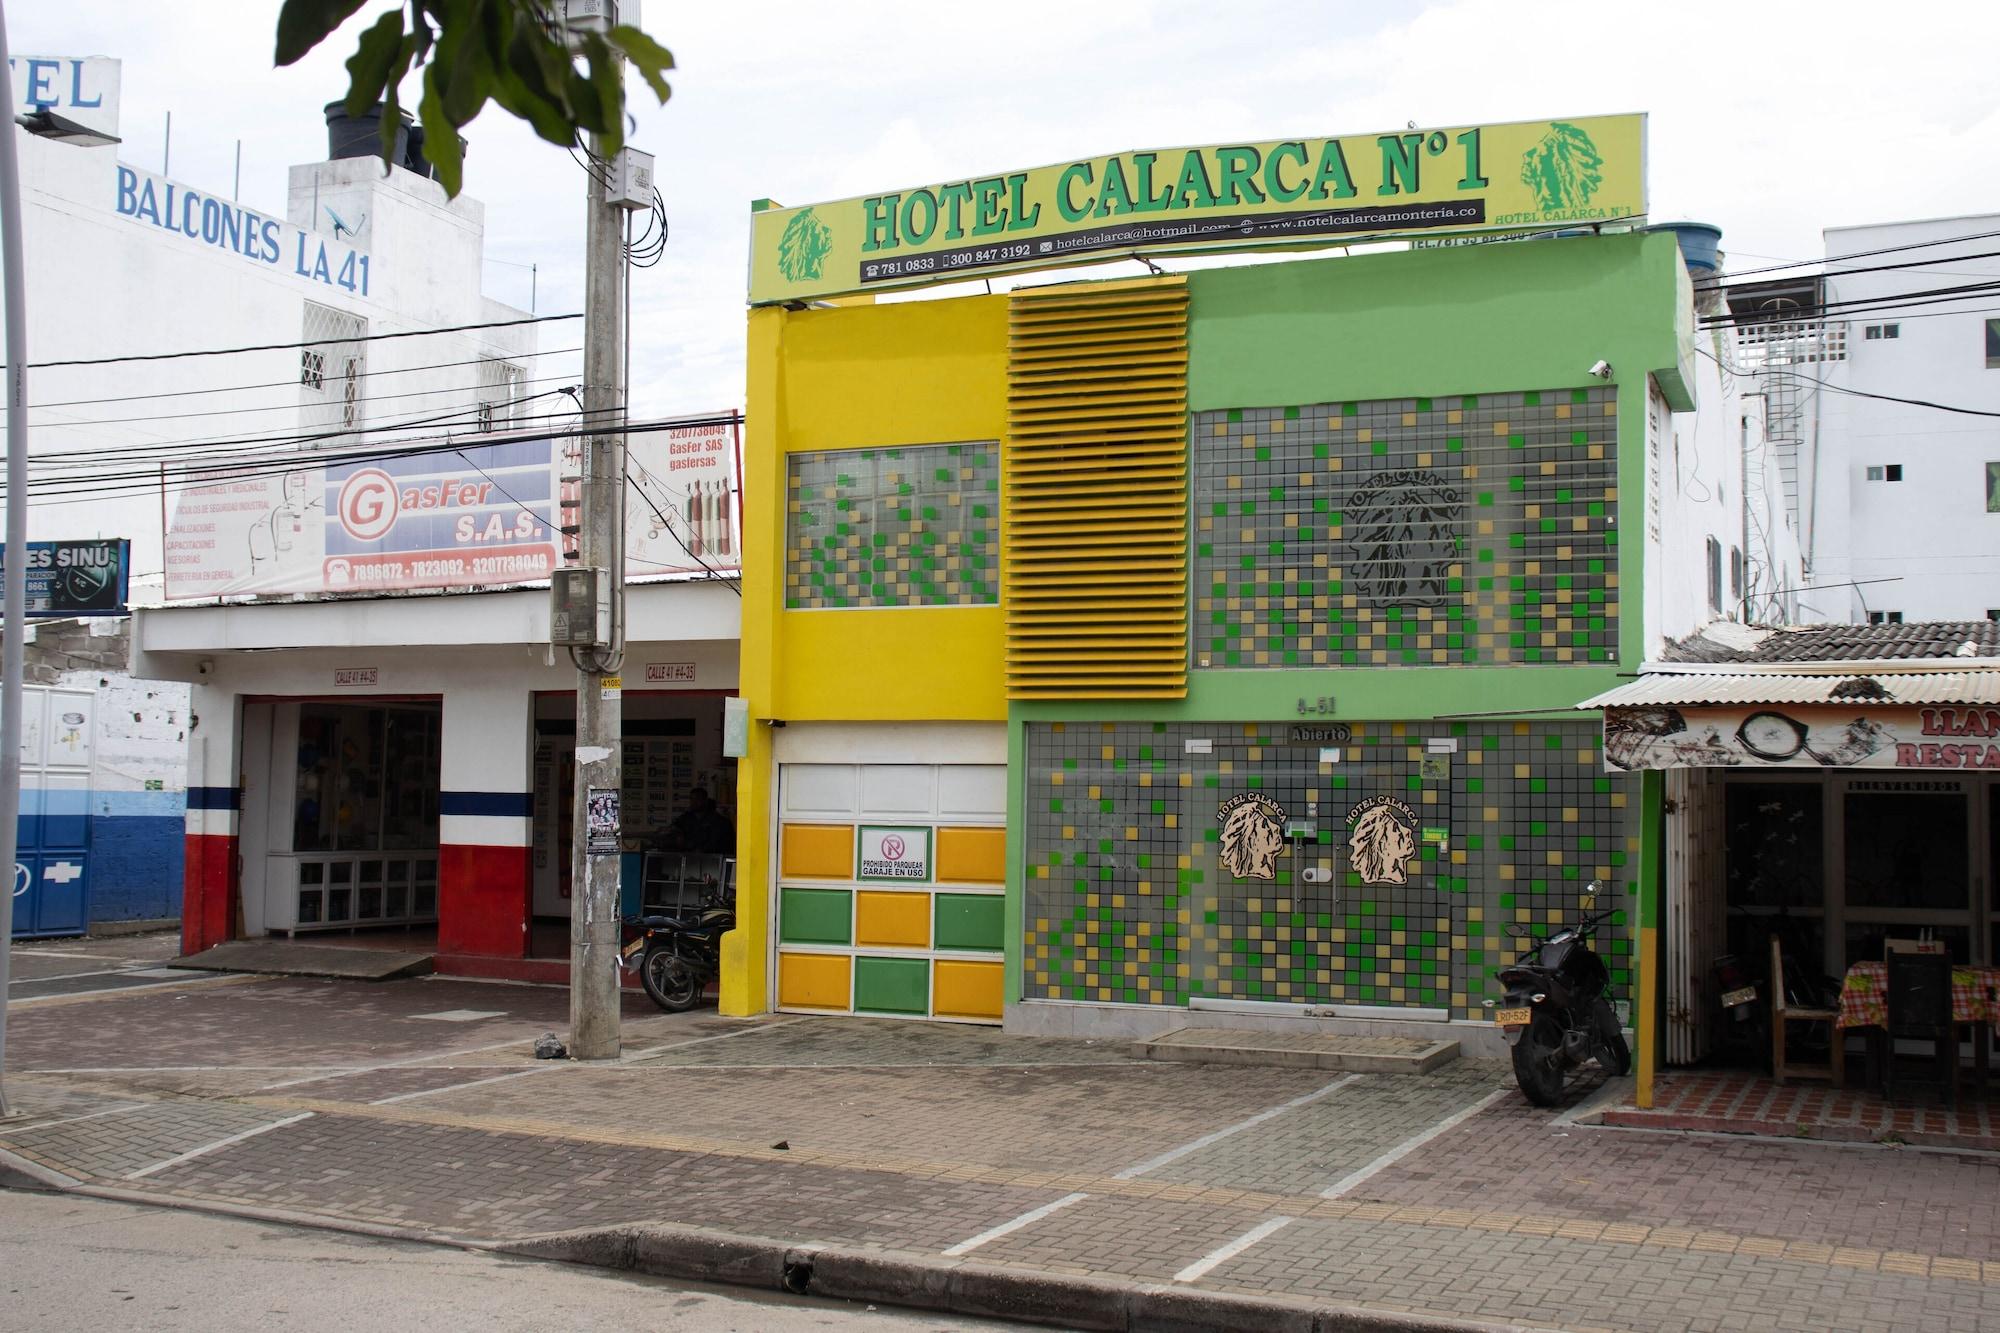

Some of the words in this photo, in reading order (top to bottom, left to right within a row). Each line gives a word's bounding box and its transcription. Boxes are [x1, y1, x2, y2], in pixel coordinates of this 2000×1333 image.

[8, 58, 102, 108] EL
[861, 173, 1041, 252] HOTEL
[1056, 139, 1357, 223] CALARCA
[1495, 213, 1539, 226] HOTEL
[1543, 208, 1607, 224] CALARCA
[116, 165, 280, 264] BALCONES
[295, 230, 332, 285] LA
[337, 249, 370, 296] 41
[881, 262, 902, 275] 781
[906, 258, 935, 272] 0833
[950, 252, 973, 266] 300
[975, 249, 997, 263] 847
[1001, 245, 1031, 259] 3192
[669, 442, 702, 455] GasFer
[705, 439, 723, 452] SAS
[669, 456, 717, 471] gasfersas
[348, 478, 493, 526] GasFer
[455, 513, 543, 542] S.A.S.
[56, 542, 110, 567] SINÚ
[353, 563, 404, 582] 7896872
[411, 558, 465, 578] 7823092
[648, 666, 664, 680] CALLE
[1292, 726, 1346, 742] Abierto
[1896, 743, 2000, 769] RESTA
[1215, 794, 1247, 823] HOTEL
[1247, 792, 1288, 824] CALARCA
[1344, 797, 1376, 826] HOTEL
[1376, 795, 1419, 827] CALARCA
[863, 860, 893, 868] PROHIBIDO
[893, 861, 923, 869] PARQUEAR
[863, 868, 893, 876] GARAJE
[907, 869, 924, 877] USO
